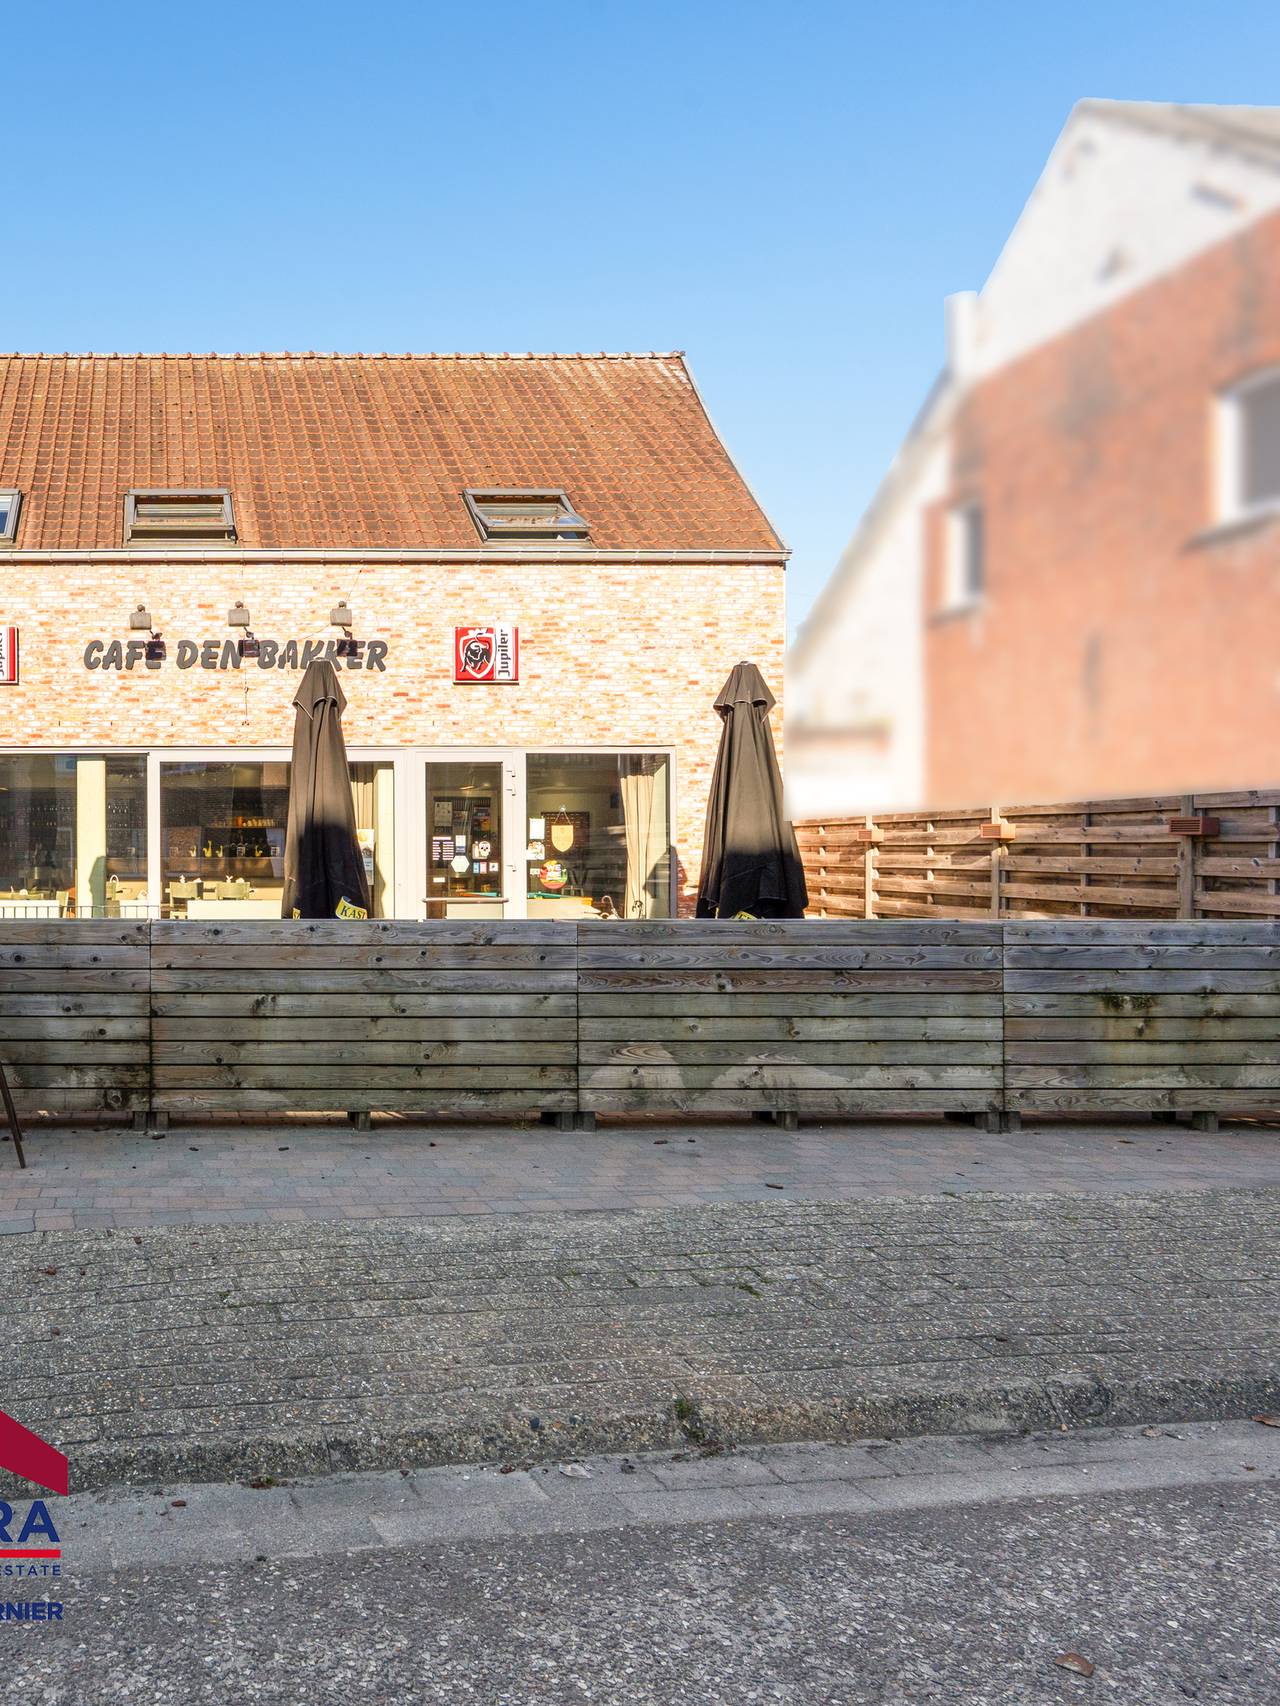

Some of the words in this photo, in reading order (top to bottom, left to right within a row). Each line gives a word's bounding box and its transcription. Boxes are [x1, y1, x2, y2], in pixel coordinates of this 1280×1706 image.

[84, 640, 165, 670] CAFE
[176, 640, 243, 669] DEN
[257, 640, 389, 672] BAKKER
[498, 629, 511, 676] Jupiler
